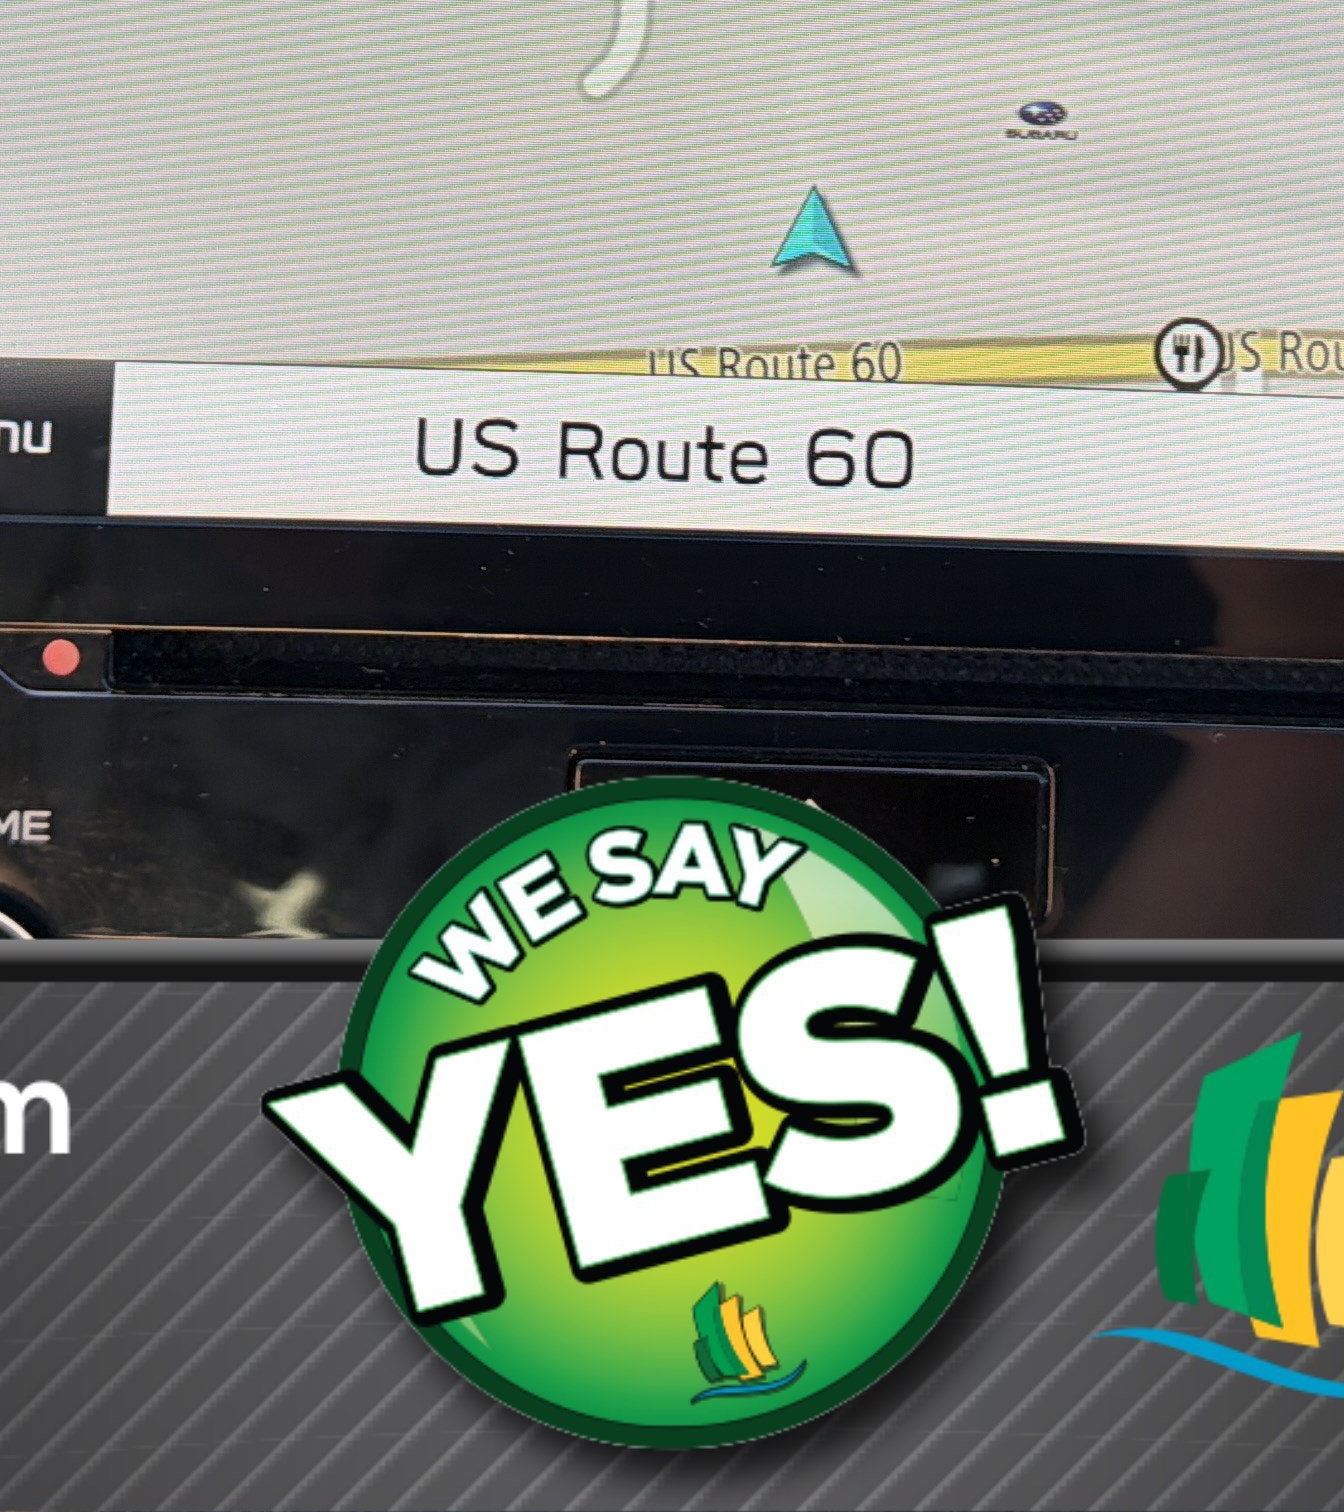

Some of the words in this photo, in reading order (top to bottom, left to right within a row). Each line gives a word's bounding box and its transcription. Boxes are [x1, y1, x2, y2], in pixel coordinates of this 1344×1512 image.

[719, 345, 835, 379] Route
[852, 340, 902, 382] 60
[416, 417, 518, 477] US
[558, 421, 769, 485] Route
[807, 427, 914, 489] 60
